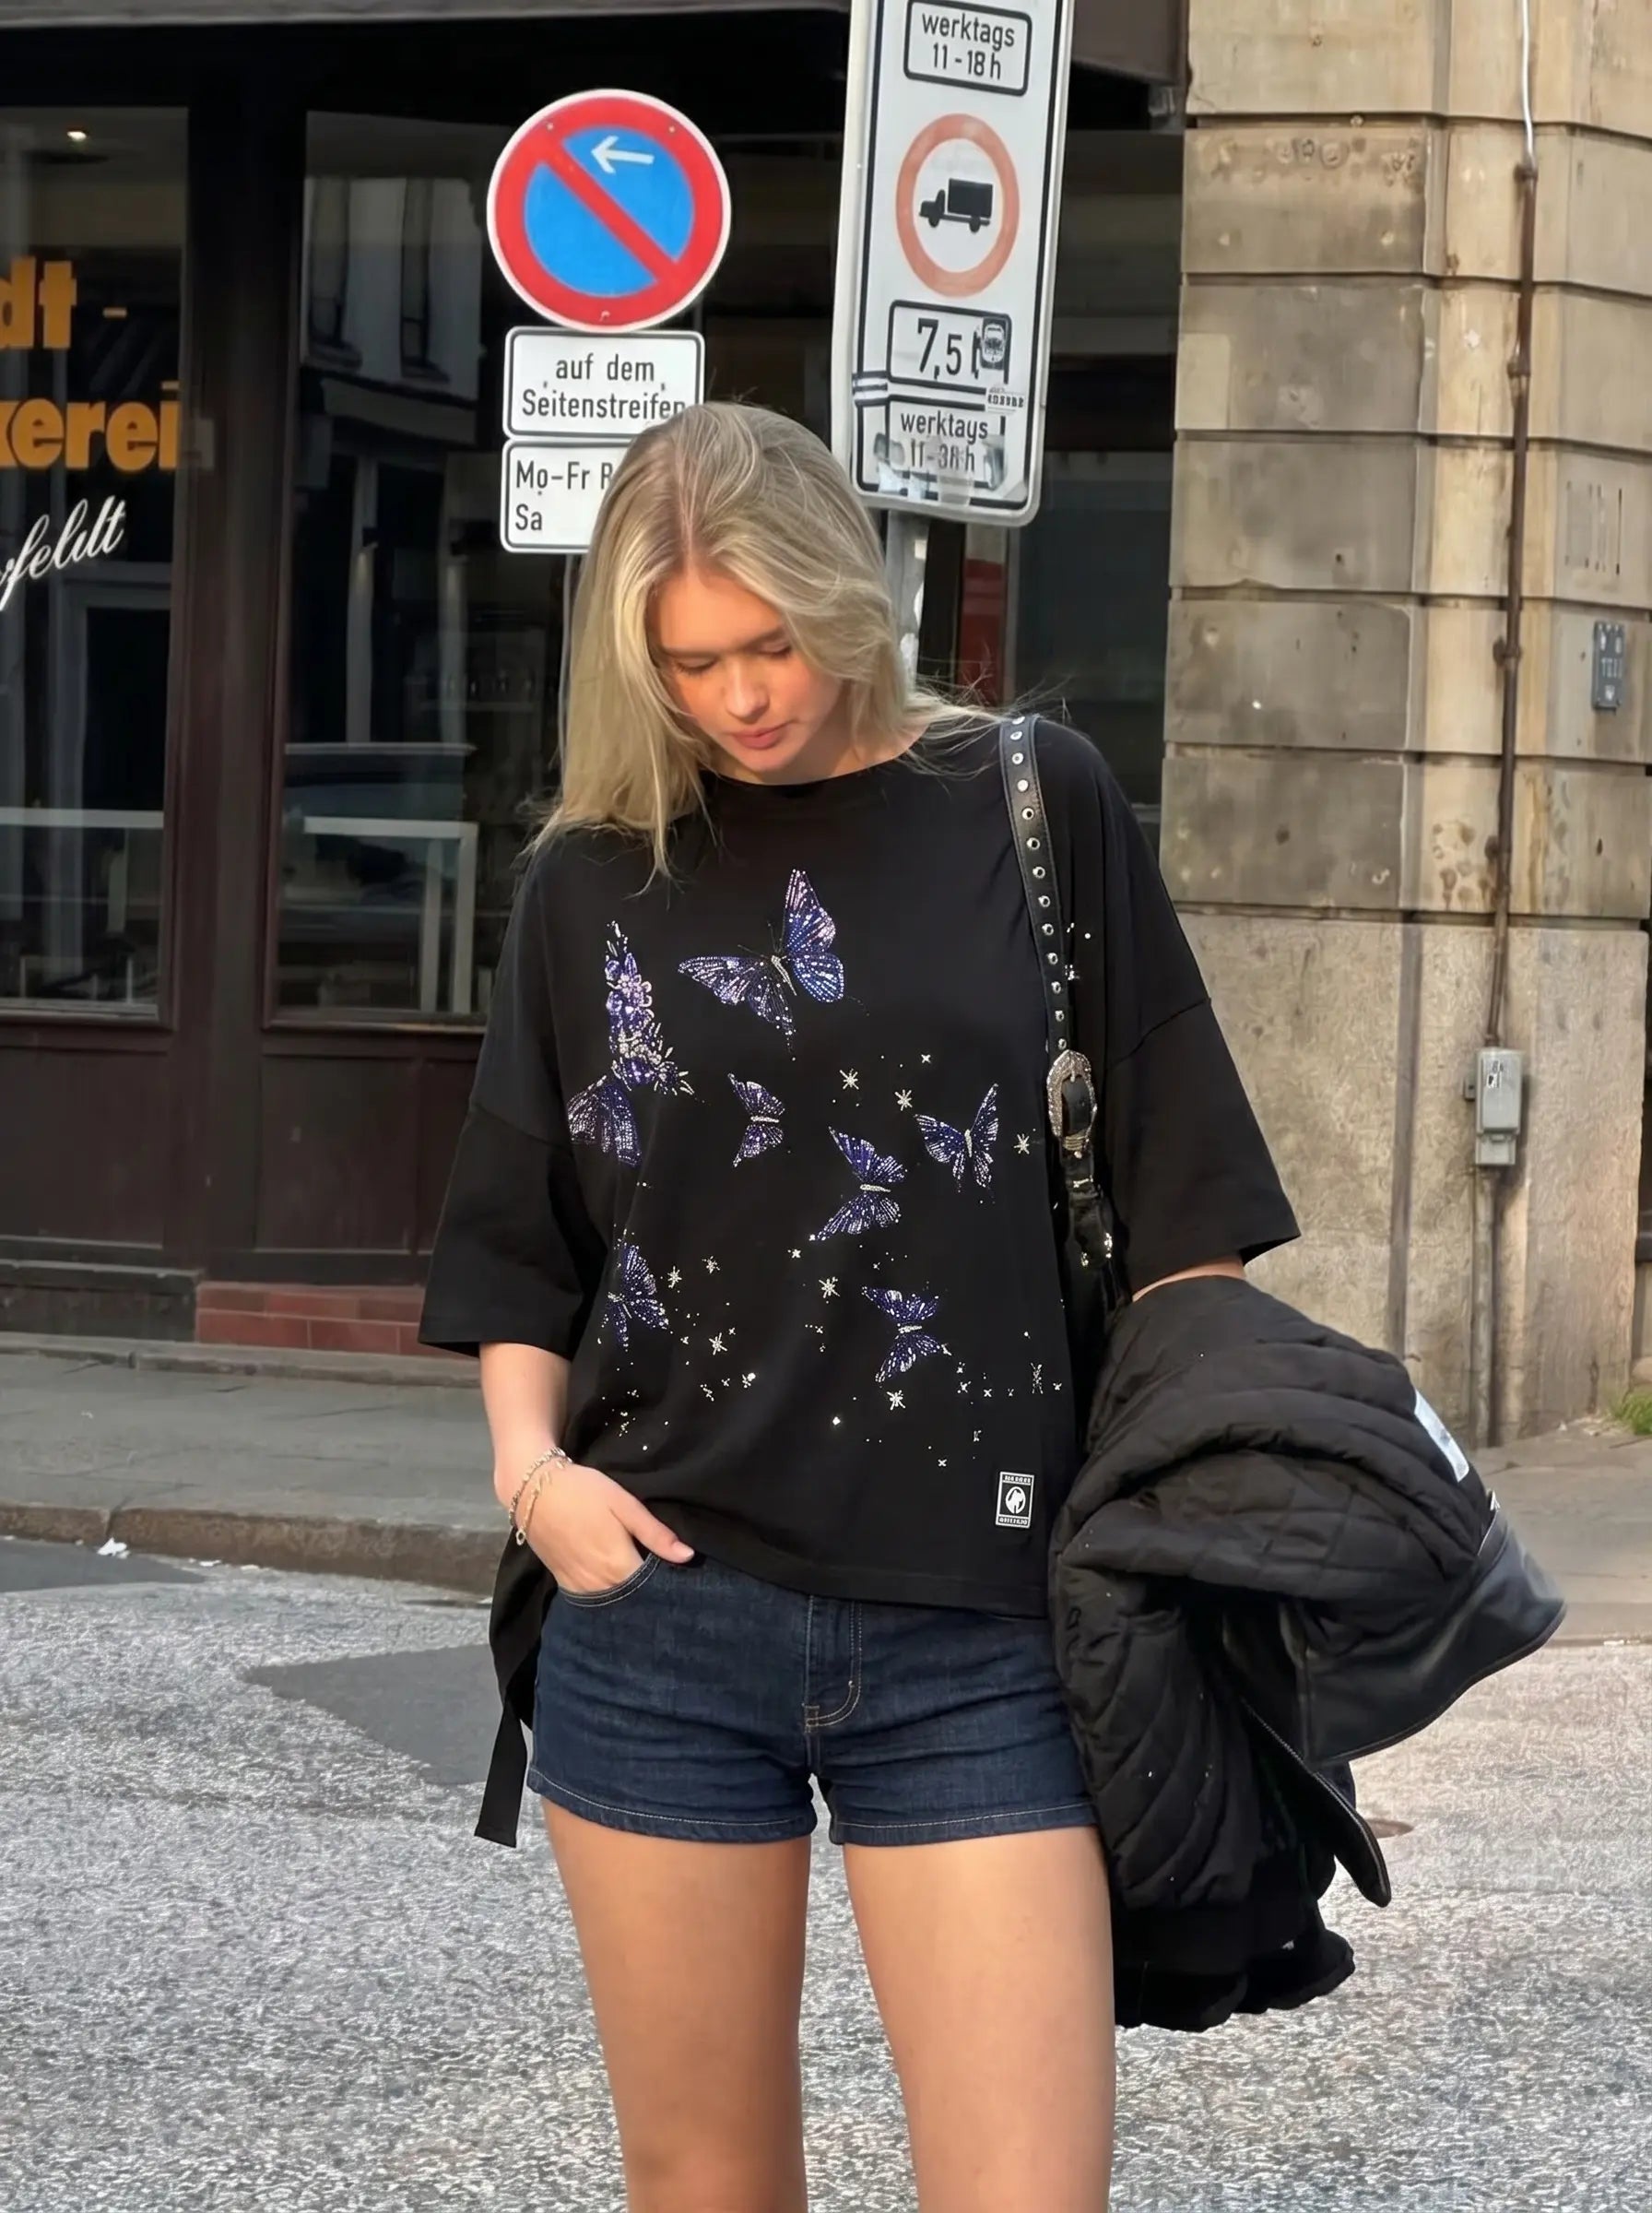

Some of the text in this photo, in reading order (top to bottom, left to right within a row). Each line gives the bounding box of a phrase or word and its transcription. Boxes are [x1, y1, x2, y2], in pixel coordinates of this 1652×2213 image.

[922, 12, 1015, 52] werktags
[556, 352, 655, 382] auf dem
[522, 388, 686, 420] Seitenstreifen
[516, 460, 590, 490] Mo-Fr
[515, 503, 543, 531] Sa
